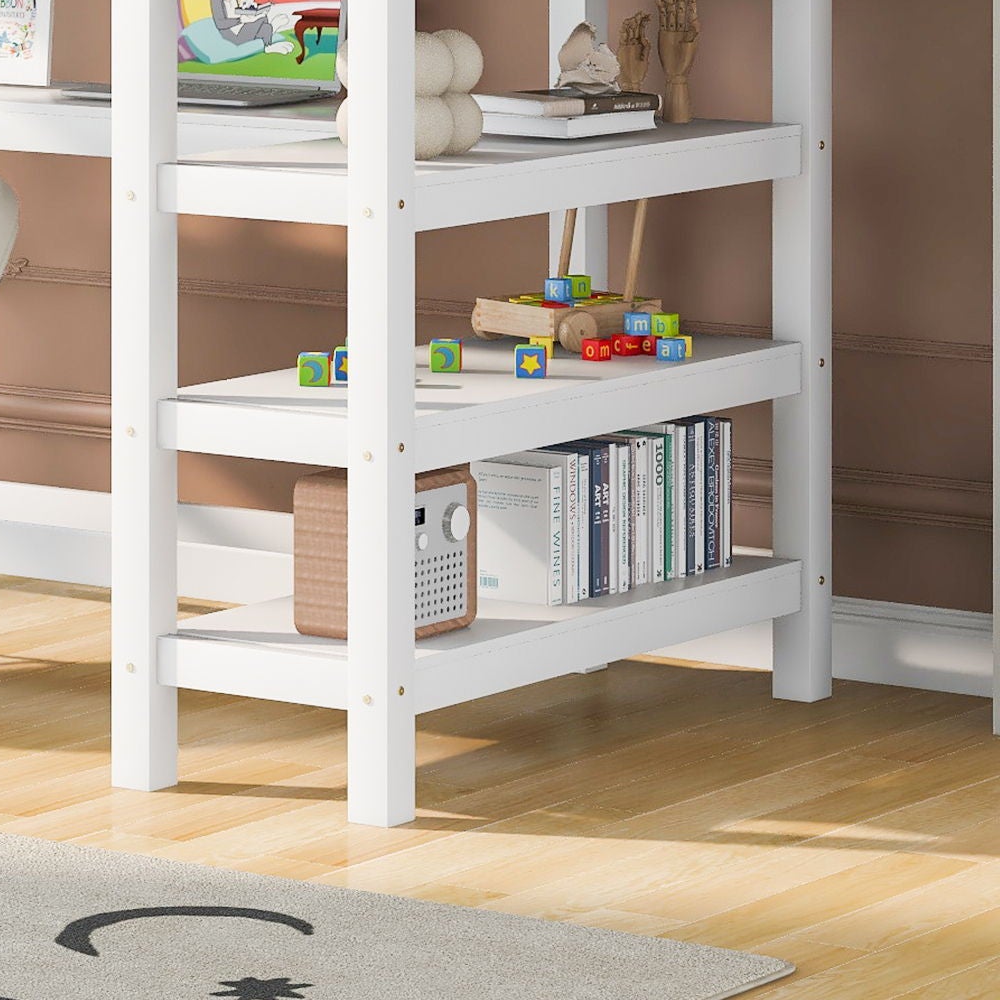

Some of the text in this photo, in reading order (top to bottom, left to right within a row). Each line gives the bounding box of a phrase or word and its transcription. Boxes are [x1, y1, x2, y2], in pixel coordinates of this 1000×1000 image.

[569, 458, 577, 521] WINDOWS
[655, 443, 663, 486] 1000
[707, 421, 715, 561] ALEXEY BRODOVITCH
[552, 486, 561, 587] FINE WINES
